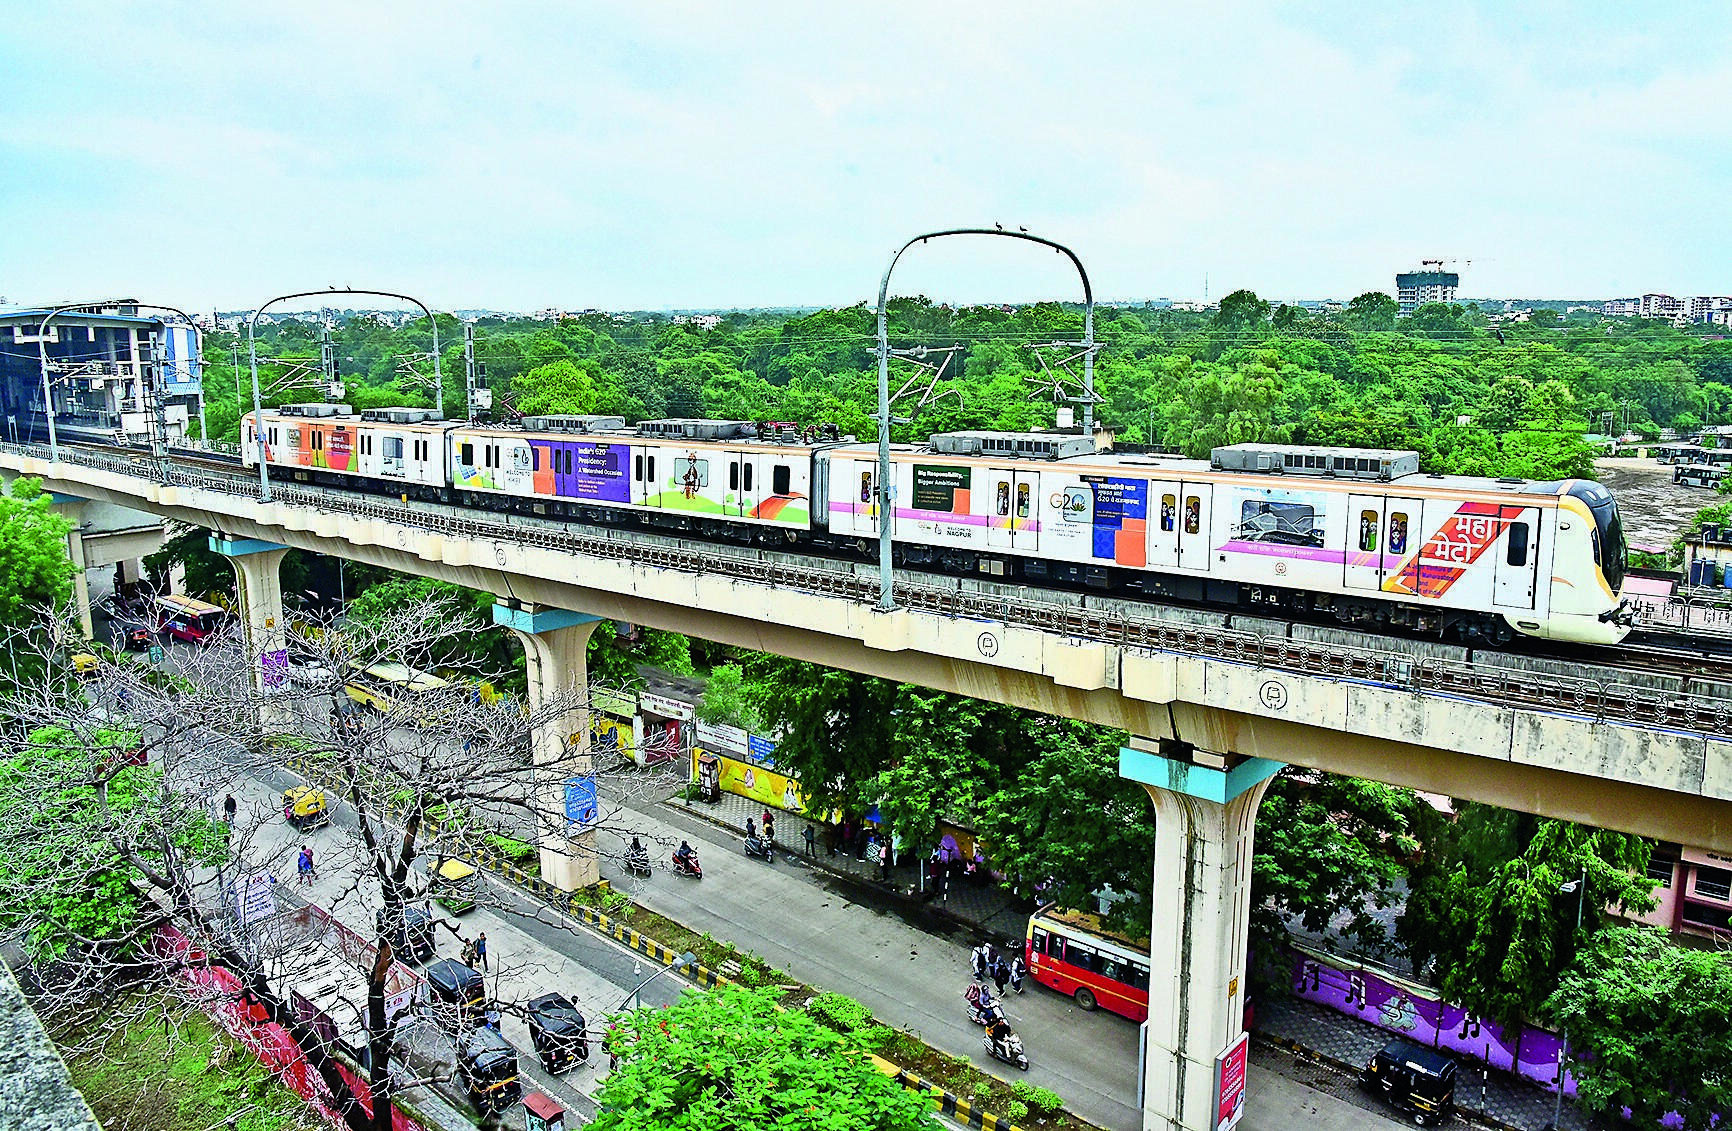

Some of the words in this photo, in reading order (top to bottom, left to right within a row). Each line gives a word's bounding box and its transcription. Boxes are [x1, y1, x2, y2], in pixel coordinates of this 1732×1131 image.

[1050, 493, 1086, 512] G20
[946, 530, 971, 538] NAGPUR
[1454, 515, 1495, 540] महा
